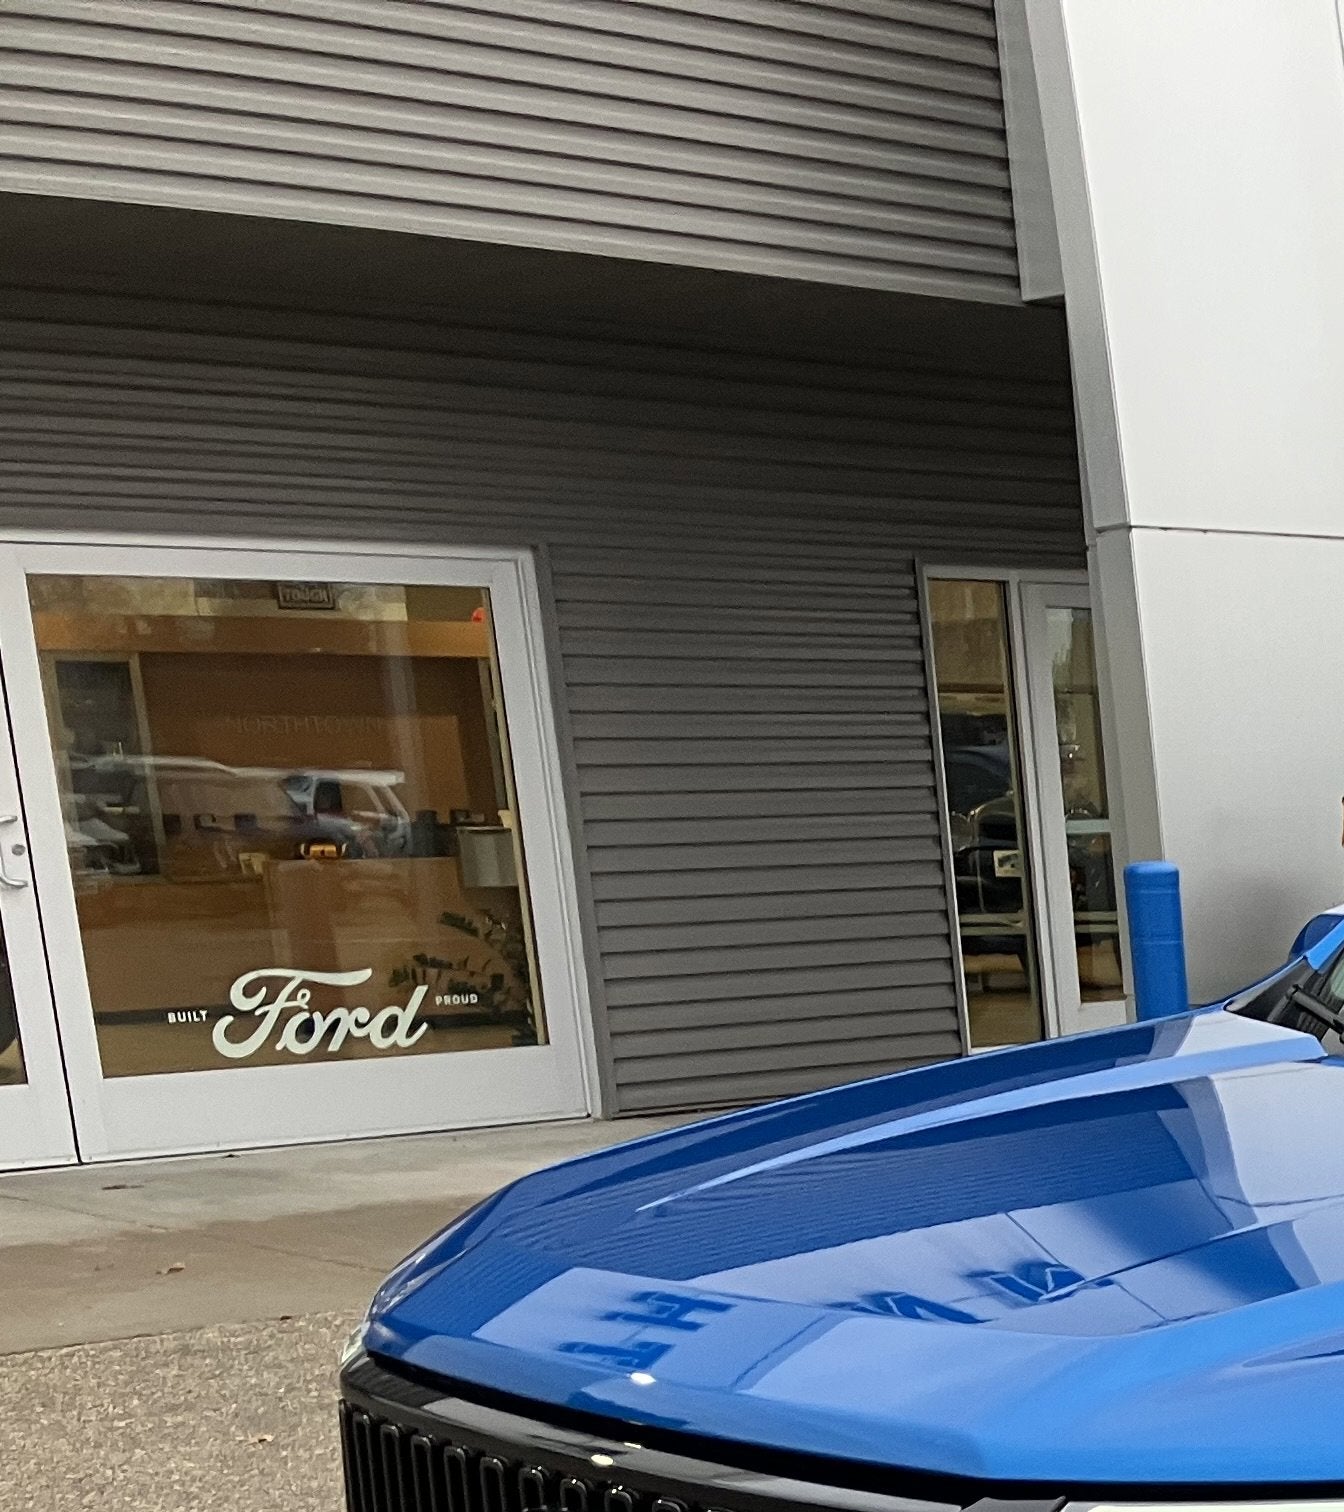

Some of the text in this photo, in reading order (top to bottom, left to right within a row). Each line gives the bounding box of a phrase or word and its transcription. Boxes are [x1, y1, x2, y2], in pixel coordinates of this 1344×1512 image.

[167, 967, 479, 1058] BUILT Ford PROUD
